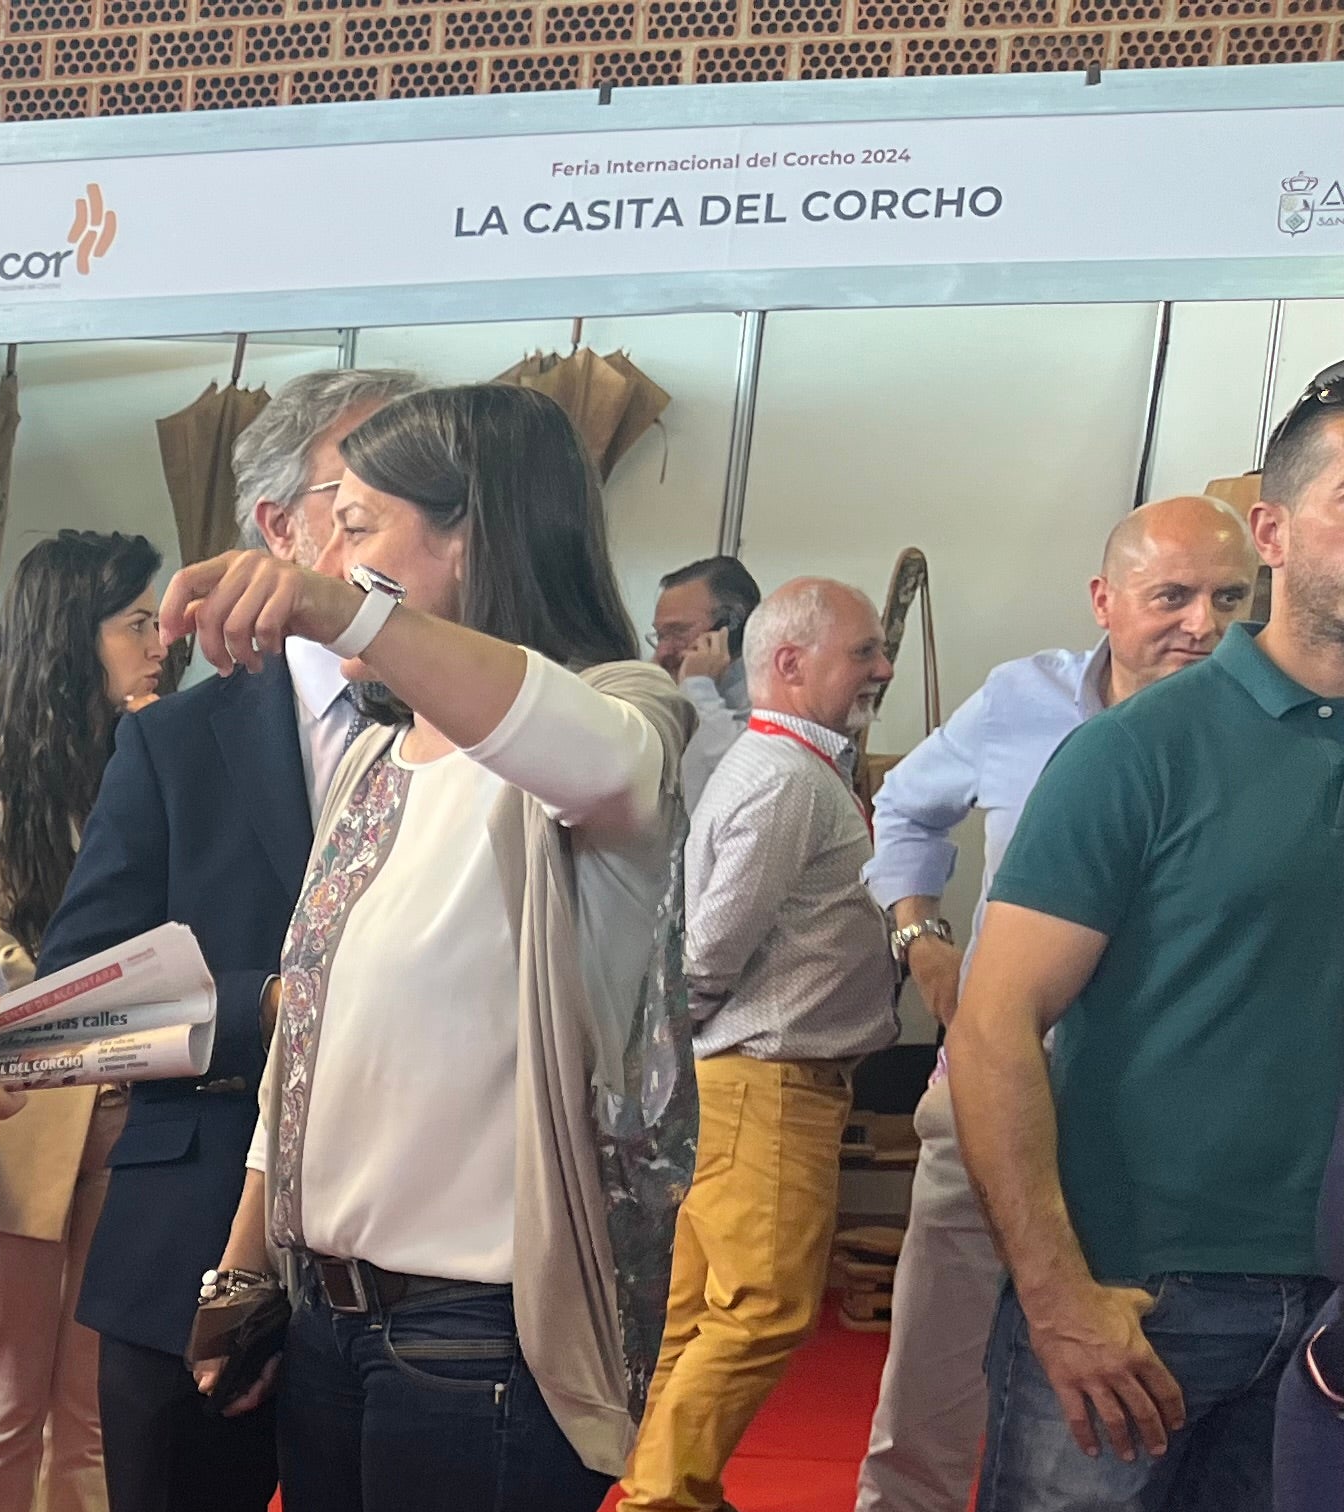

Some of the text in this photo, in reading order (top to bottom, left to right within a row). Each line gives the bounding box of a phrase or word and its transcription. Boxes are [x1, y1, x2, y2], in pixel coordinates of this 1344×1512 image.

[551, 148, 911, 178] Feria Internacional del Corcho 2024
[454, 185, 1003, 238] LA CASITA DEL CORCHO
[82, 1010, 128, 1028] calles
